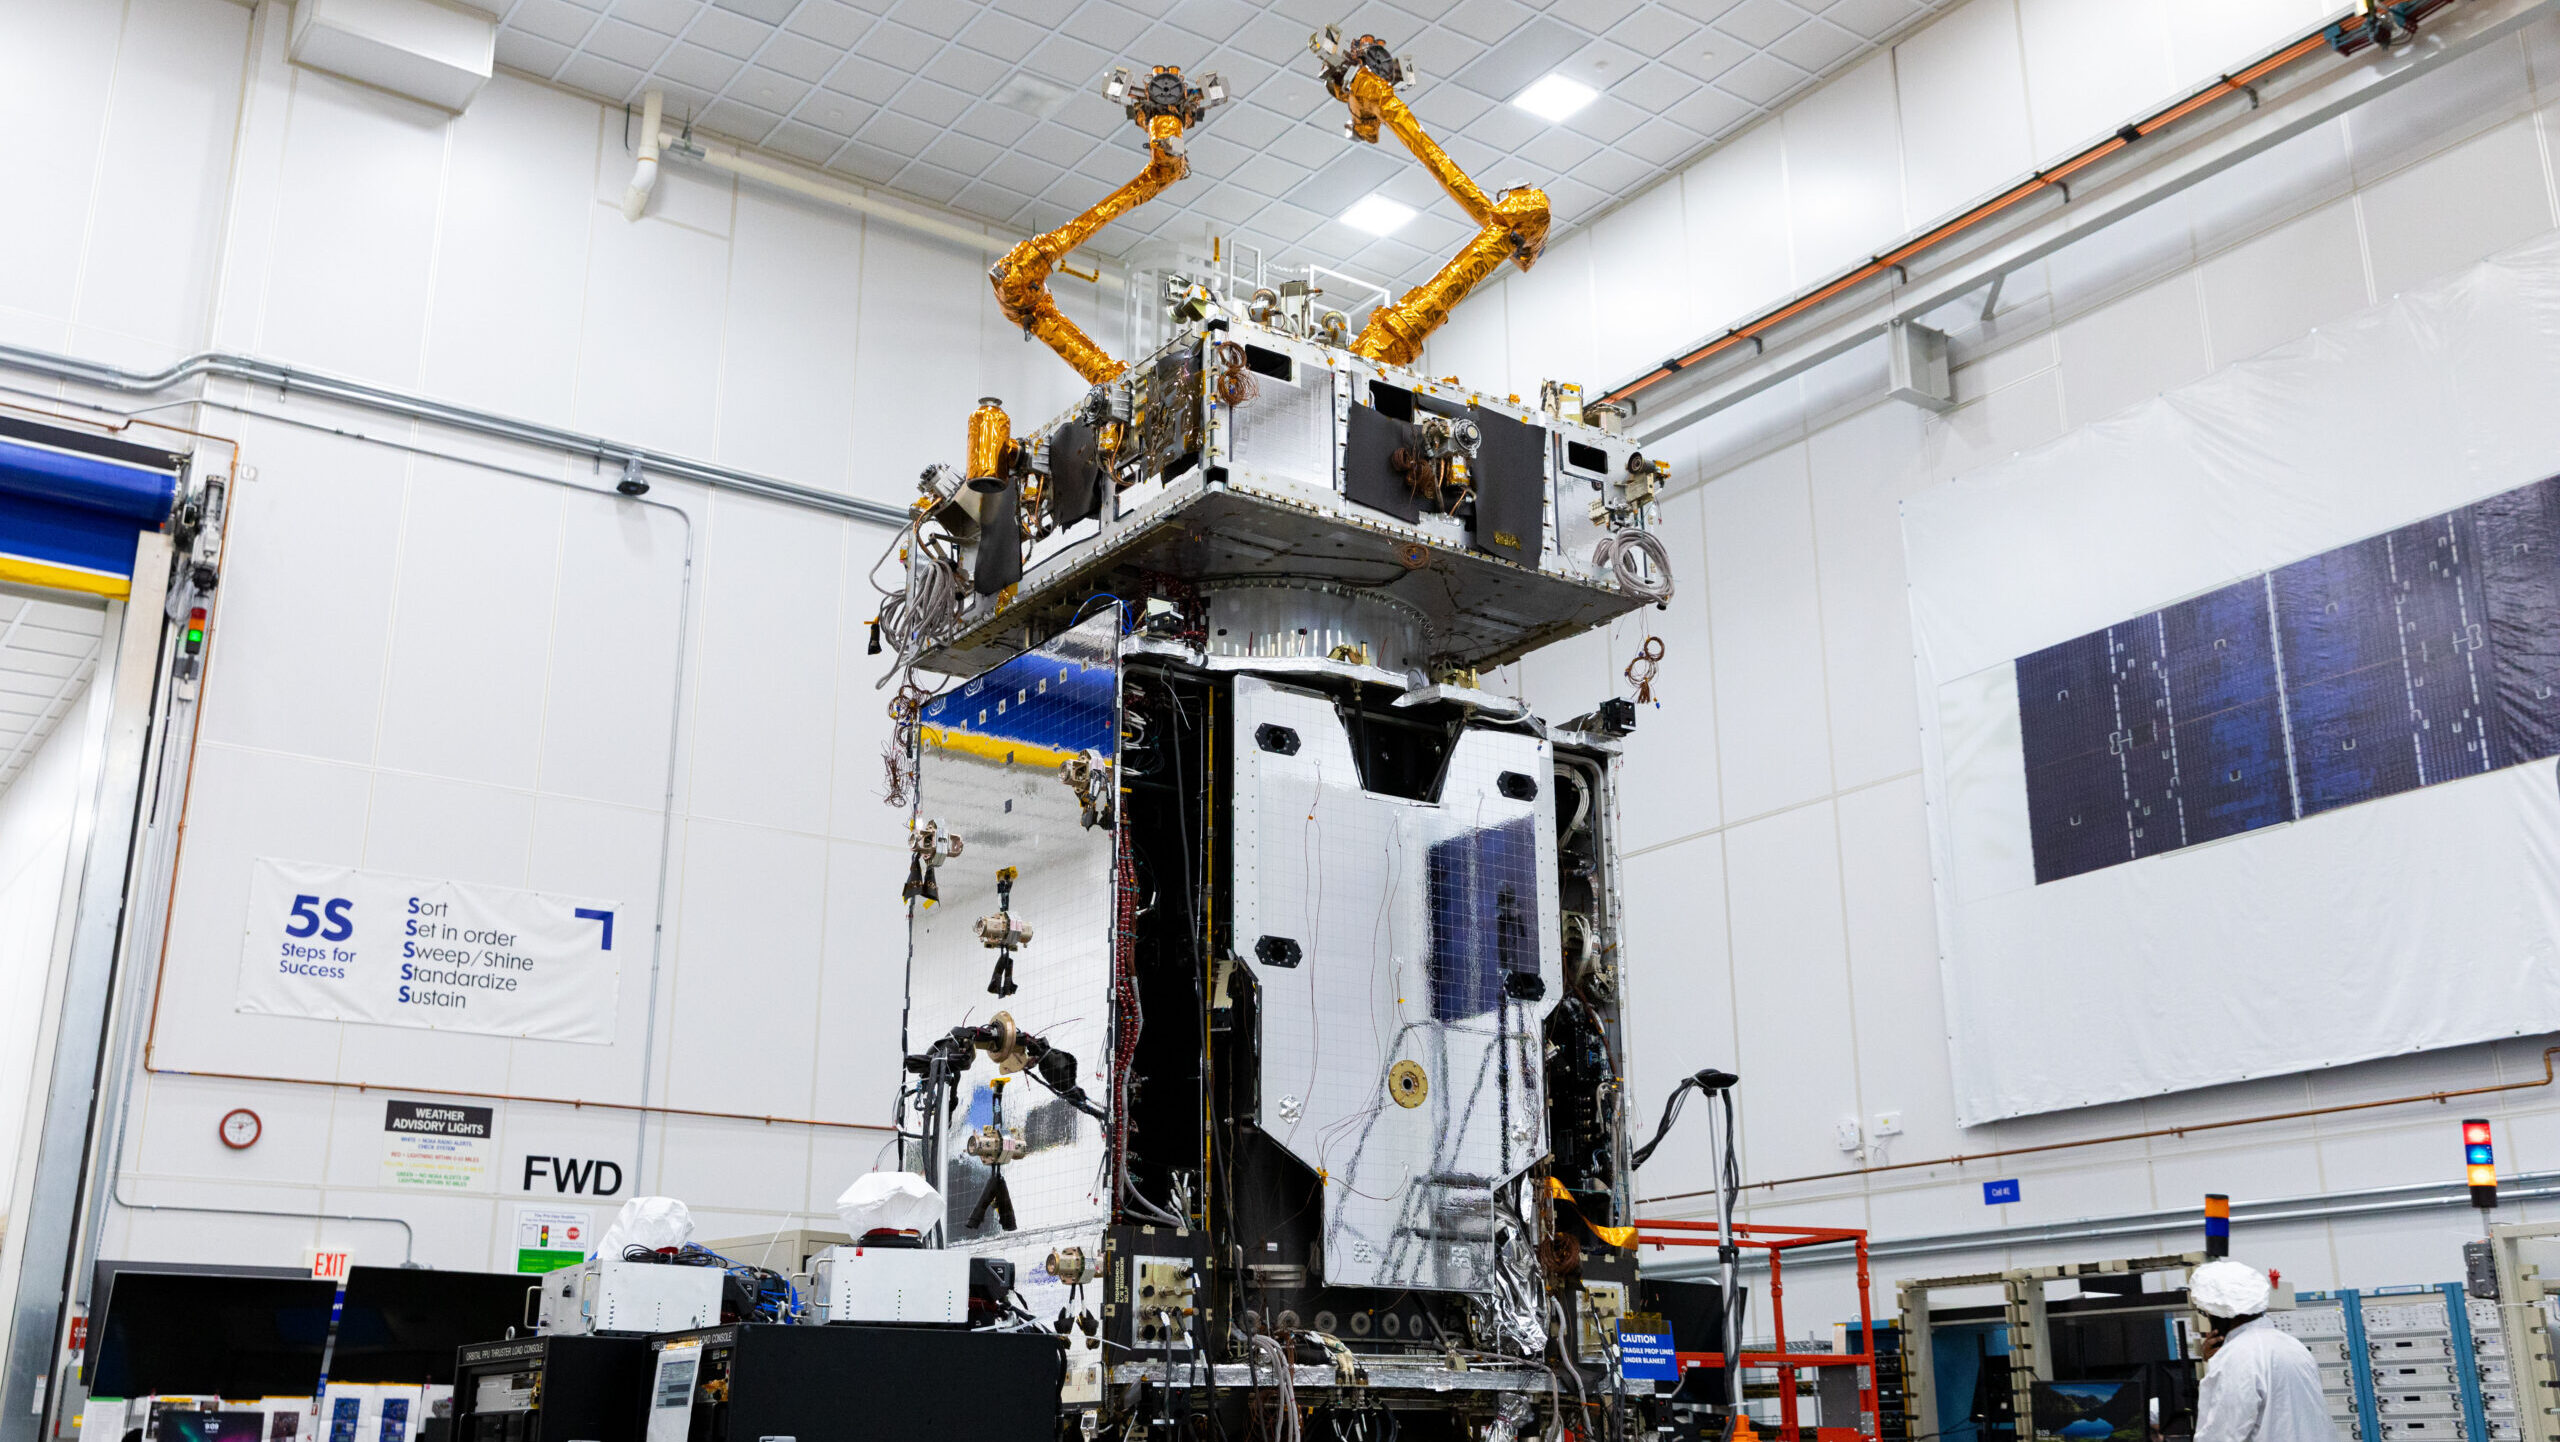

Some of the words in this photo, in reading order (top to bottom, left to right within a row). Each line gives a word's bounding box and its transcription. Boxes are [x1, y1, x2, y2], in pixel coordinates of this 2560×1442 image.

[407, 897, 448, 917] Sort
[286, 894, 354, 942] 5S
[405, 919, 436, 938] Set
[442, 924, 458, 940] in
[464, 930, 517, 947] order
[281, 943, 326, 962] Steps
[333, 947, 357, 962] for
[403, 941, 534, 971] Sweep/Shine
[279, 960, 345, 979] Success
[400, 963, 517, 991] Standardize
[398, 985, 466, 1008] Sustain
[416, 1108, 465, 1121] WEATHER
[392, 1118, 446, 1132] ADVISORY
[447, 1122, 484, 1135] LIGHTS
[523, 1155, 622, 1196] FWD
[314, 1253, 347, 1277] EXIT
[1621, 1334, 1657, 1344] CAUTION
[491, 1347, 512, 1358] THRUSTER
[512, 1345, 524, 1355] LOAD
[524, 1343, 544, 1354] CONSOLE
[1660, 1348, 1674, 1356] LINES
